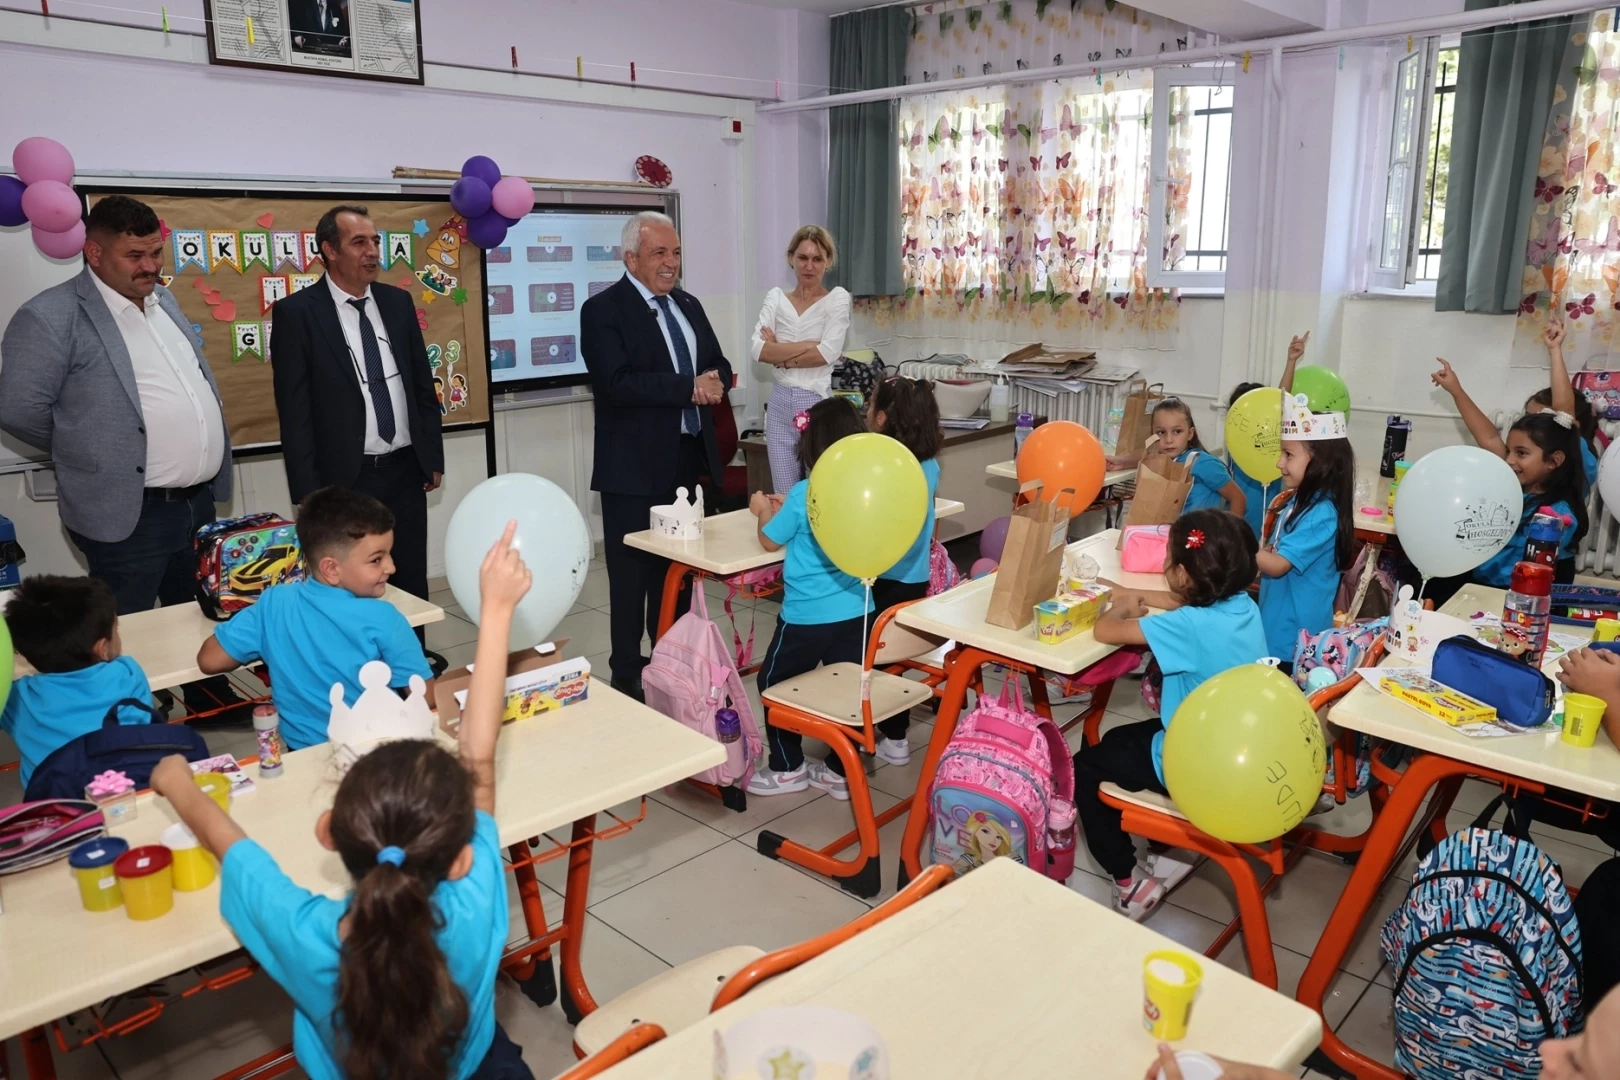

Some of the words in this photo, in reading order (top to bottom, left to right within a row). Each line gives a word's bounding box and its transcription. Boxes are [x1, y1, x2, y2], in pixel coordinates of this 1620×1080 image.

[445, 340, 460, 363] 3
[1402, 690, 1419, 703] PASTEL
[1418, 699, 1432, 709] BOYA
